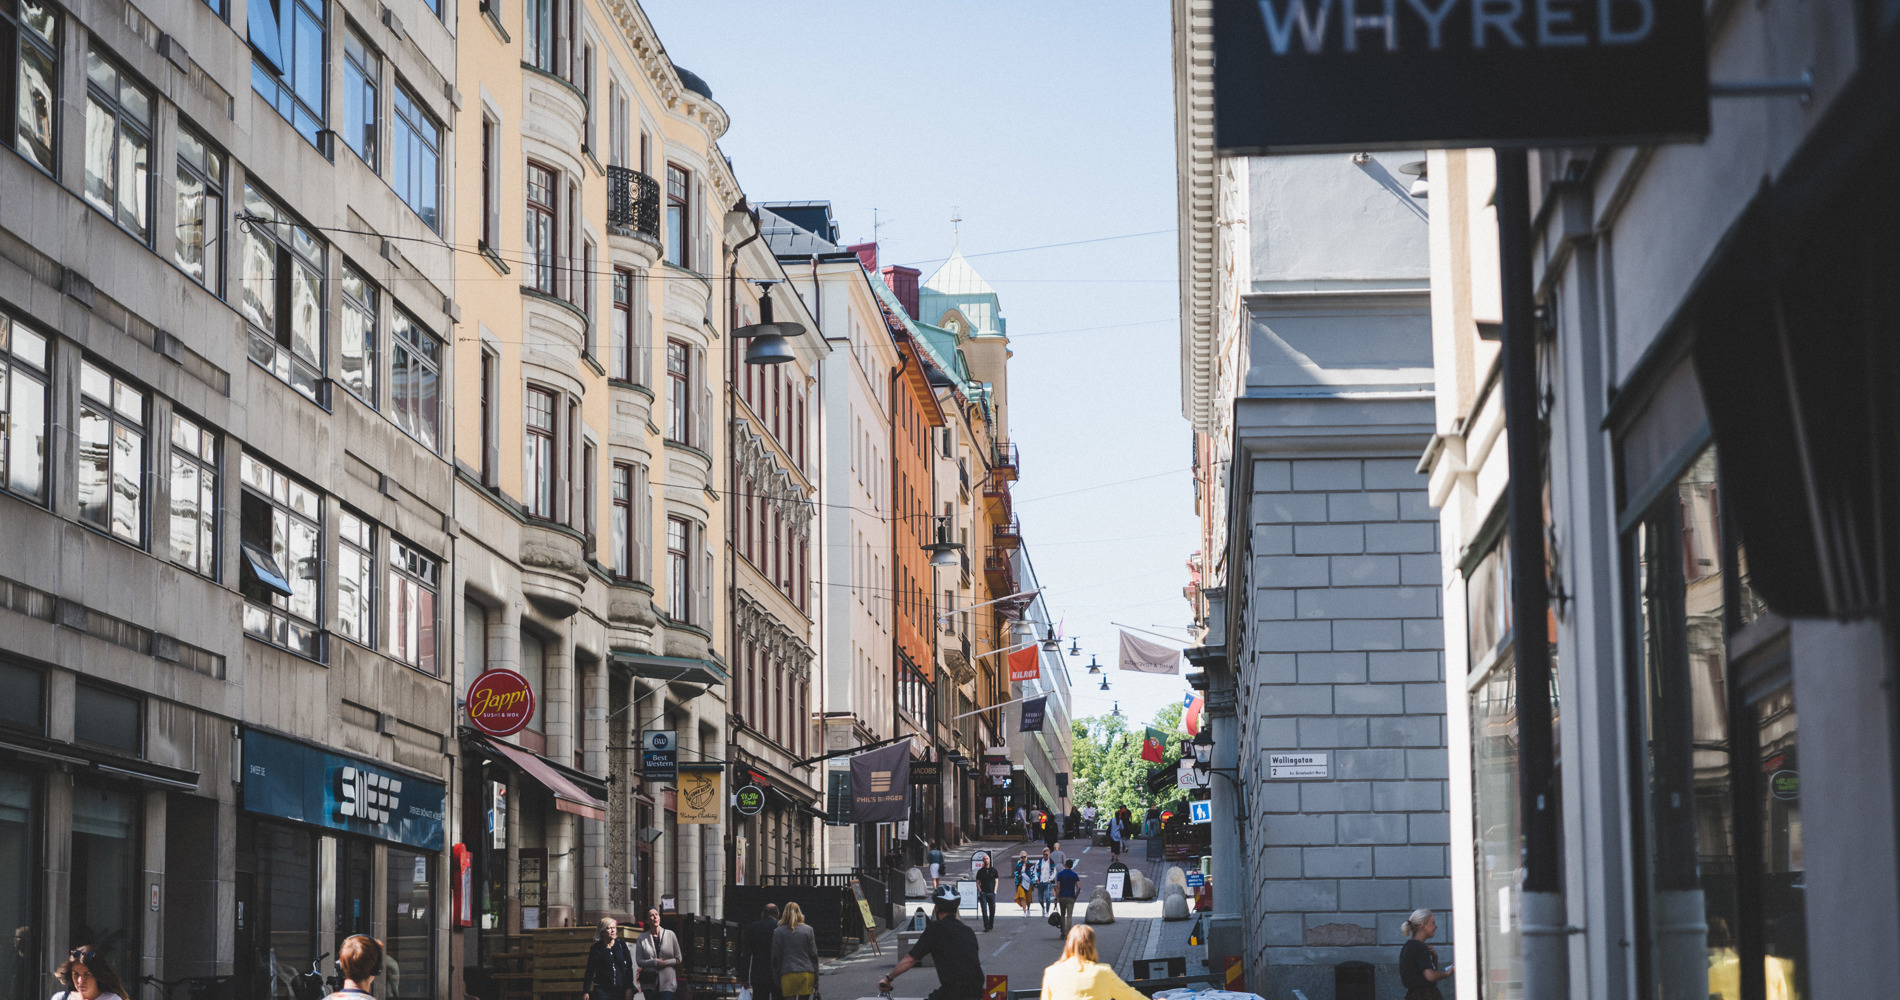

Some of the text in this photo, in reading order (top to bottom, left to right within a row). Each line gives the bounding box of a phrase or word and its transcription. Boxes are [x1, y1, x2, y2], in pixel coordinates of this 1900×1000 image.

[1259, 0, 1655, 54] WHYRED
[471, 685, 528, 717] Jappi
[1272, 756, 1313, 765] Wallingatan
[913, 767, 937, 775] JACOBS
[1272, 768, 1277, 776] 2
